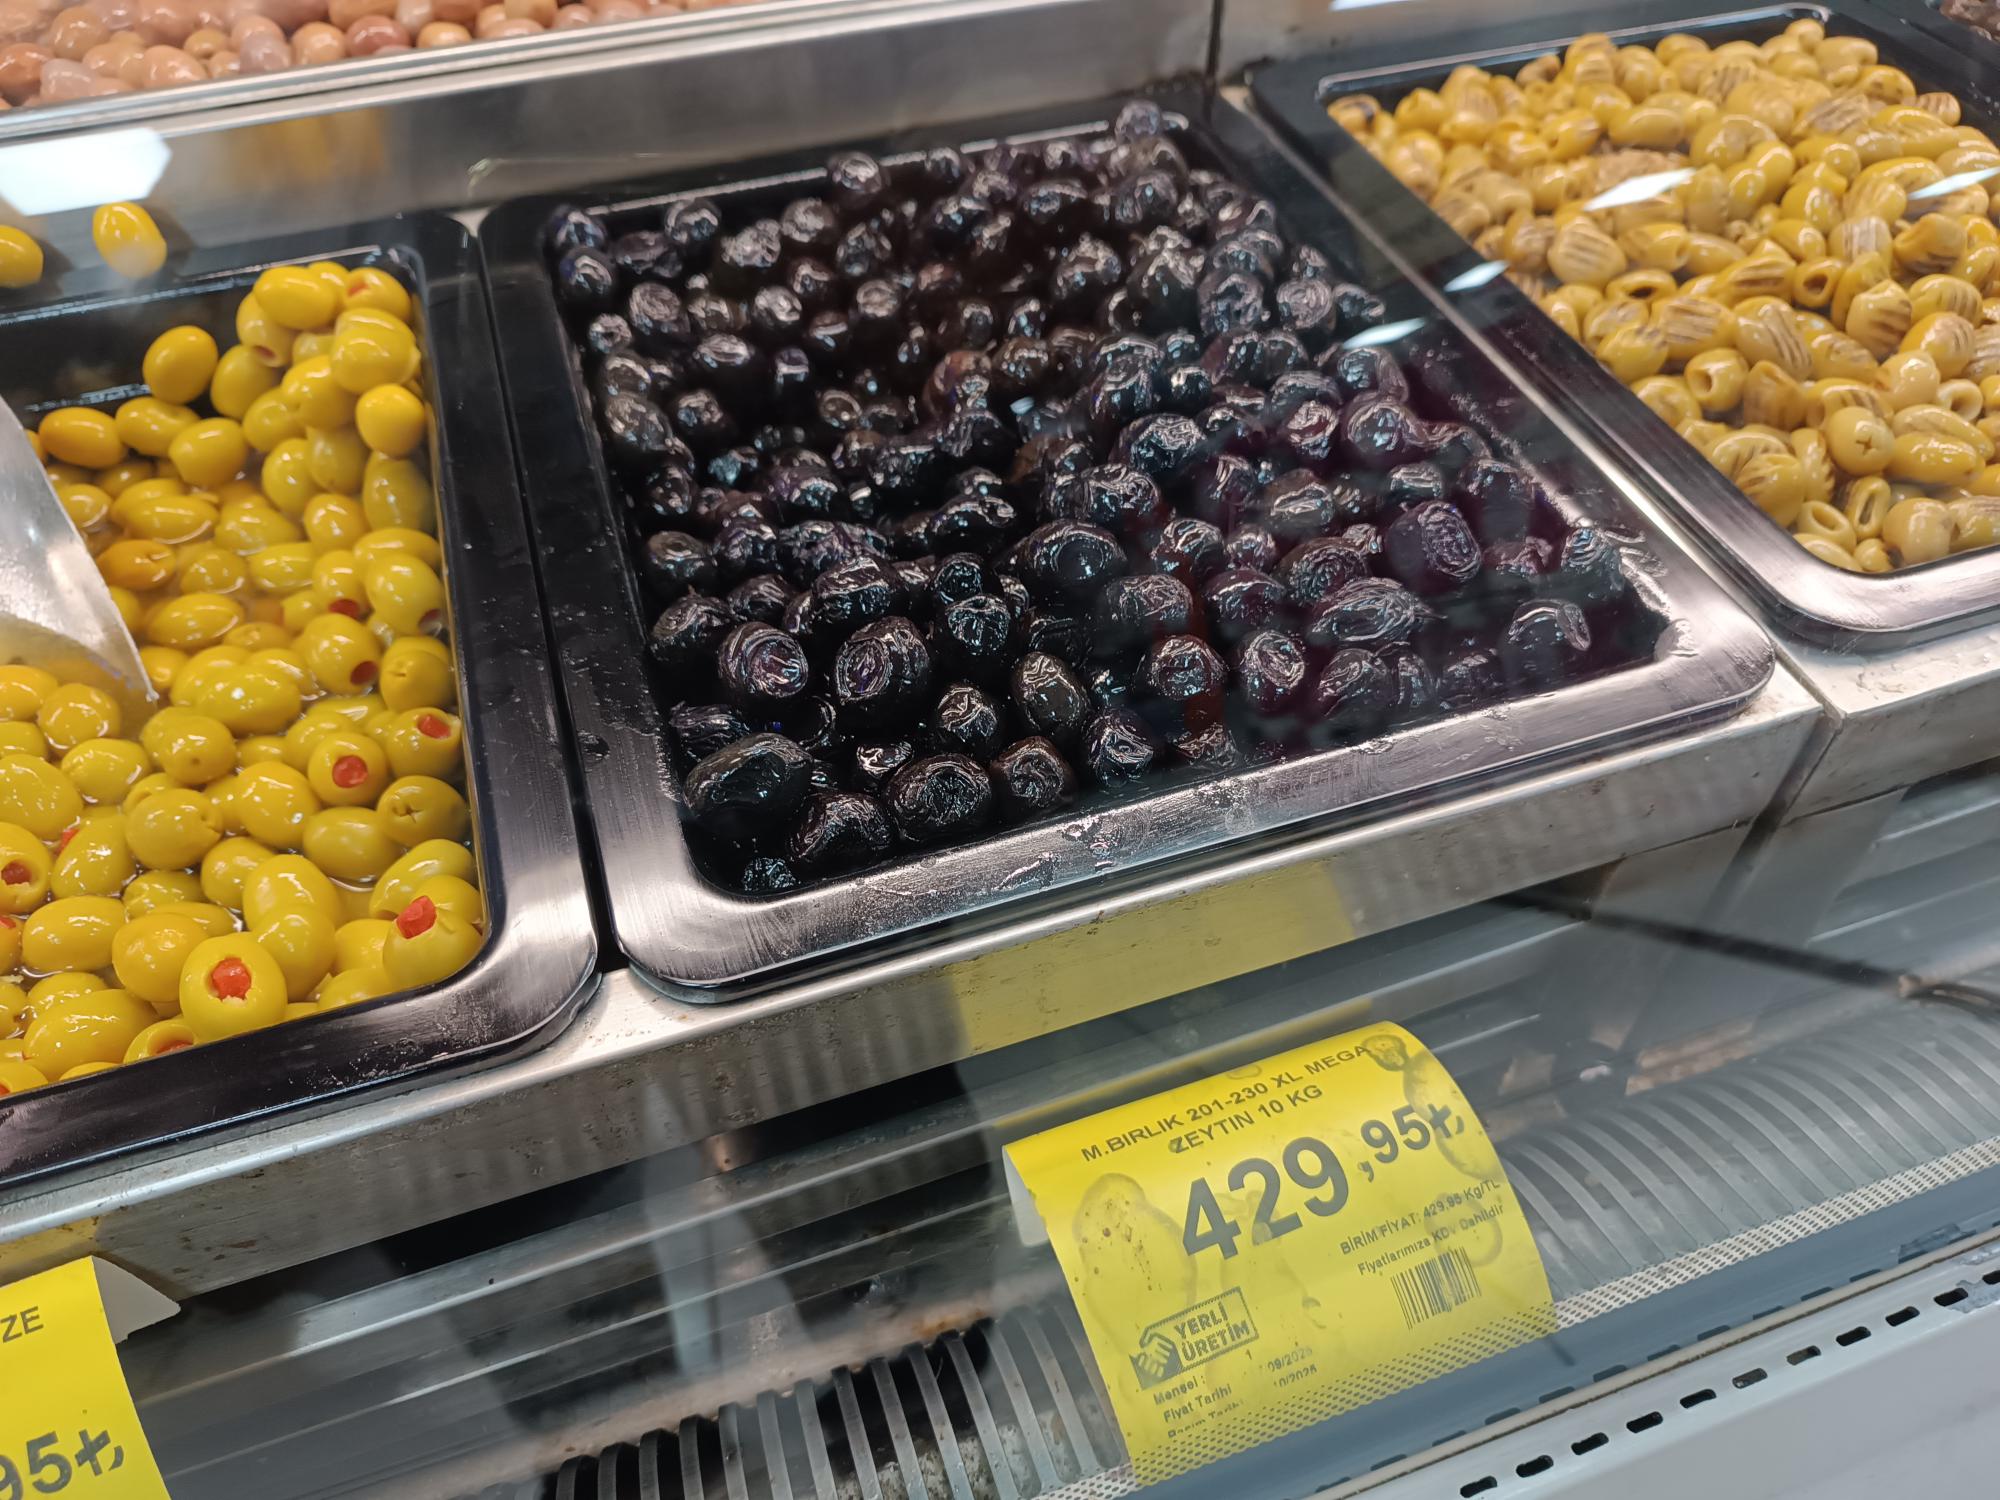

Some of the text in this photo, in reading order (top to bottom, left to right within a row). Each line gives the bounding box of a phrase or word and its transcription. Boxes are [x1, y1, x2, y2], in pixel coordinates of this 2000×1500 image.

[1081, 1044, 1369, 1162] M.BIRLIK 201-230 XL MEGA
[1169, 1084, 1323, 1154] ZEYTIN 10 KG
[1174, 1301, 1229, 1340] YERLİ
[1181, 1319, 1251, 1362] ÜRETİM
[1163, 1402, 1195, 1423] Fiyat
[1194, 1383, 1233, 1408] Tarihi
